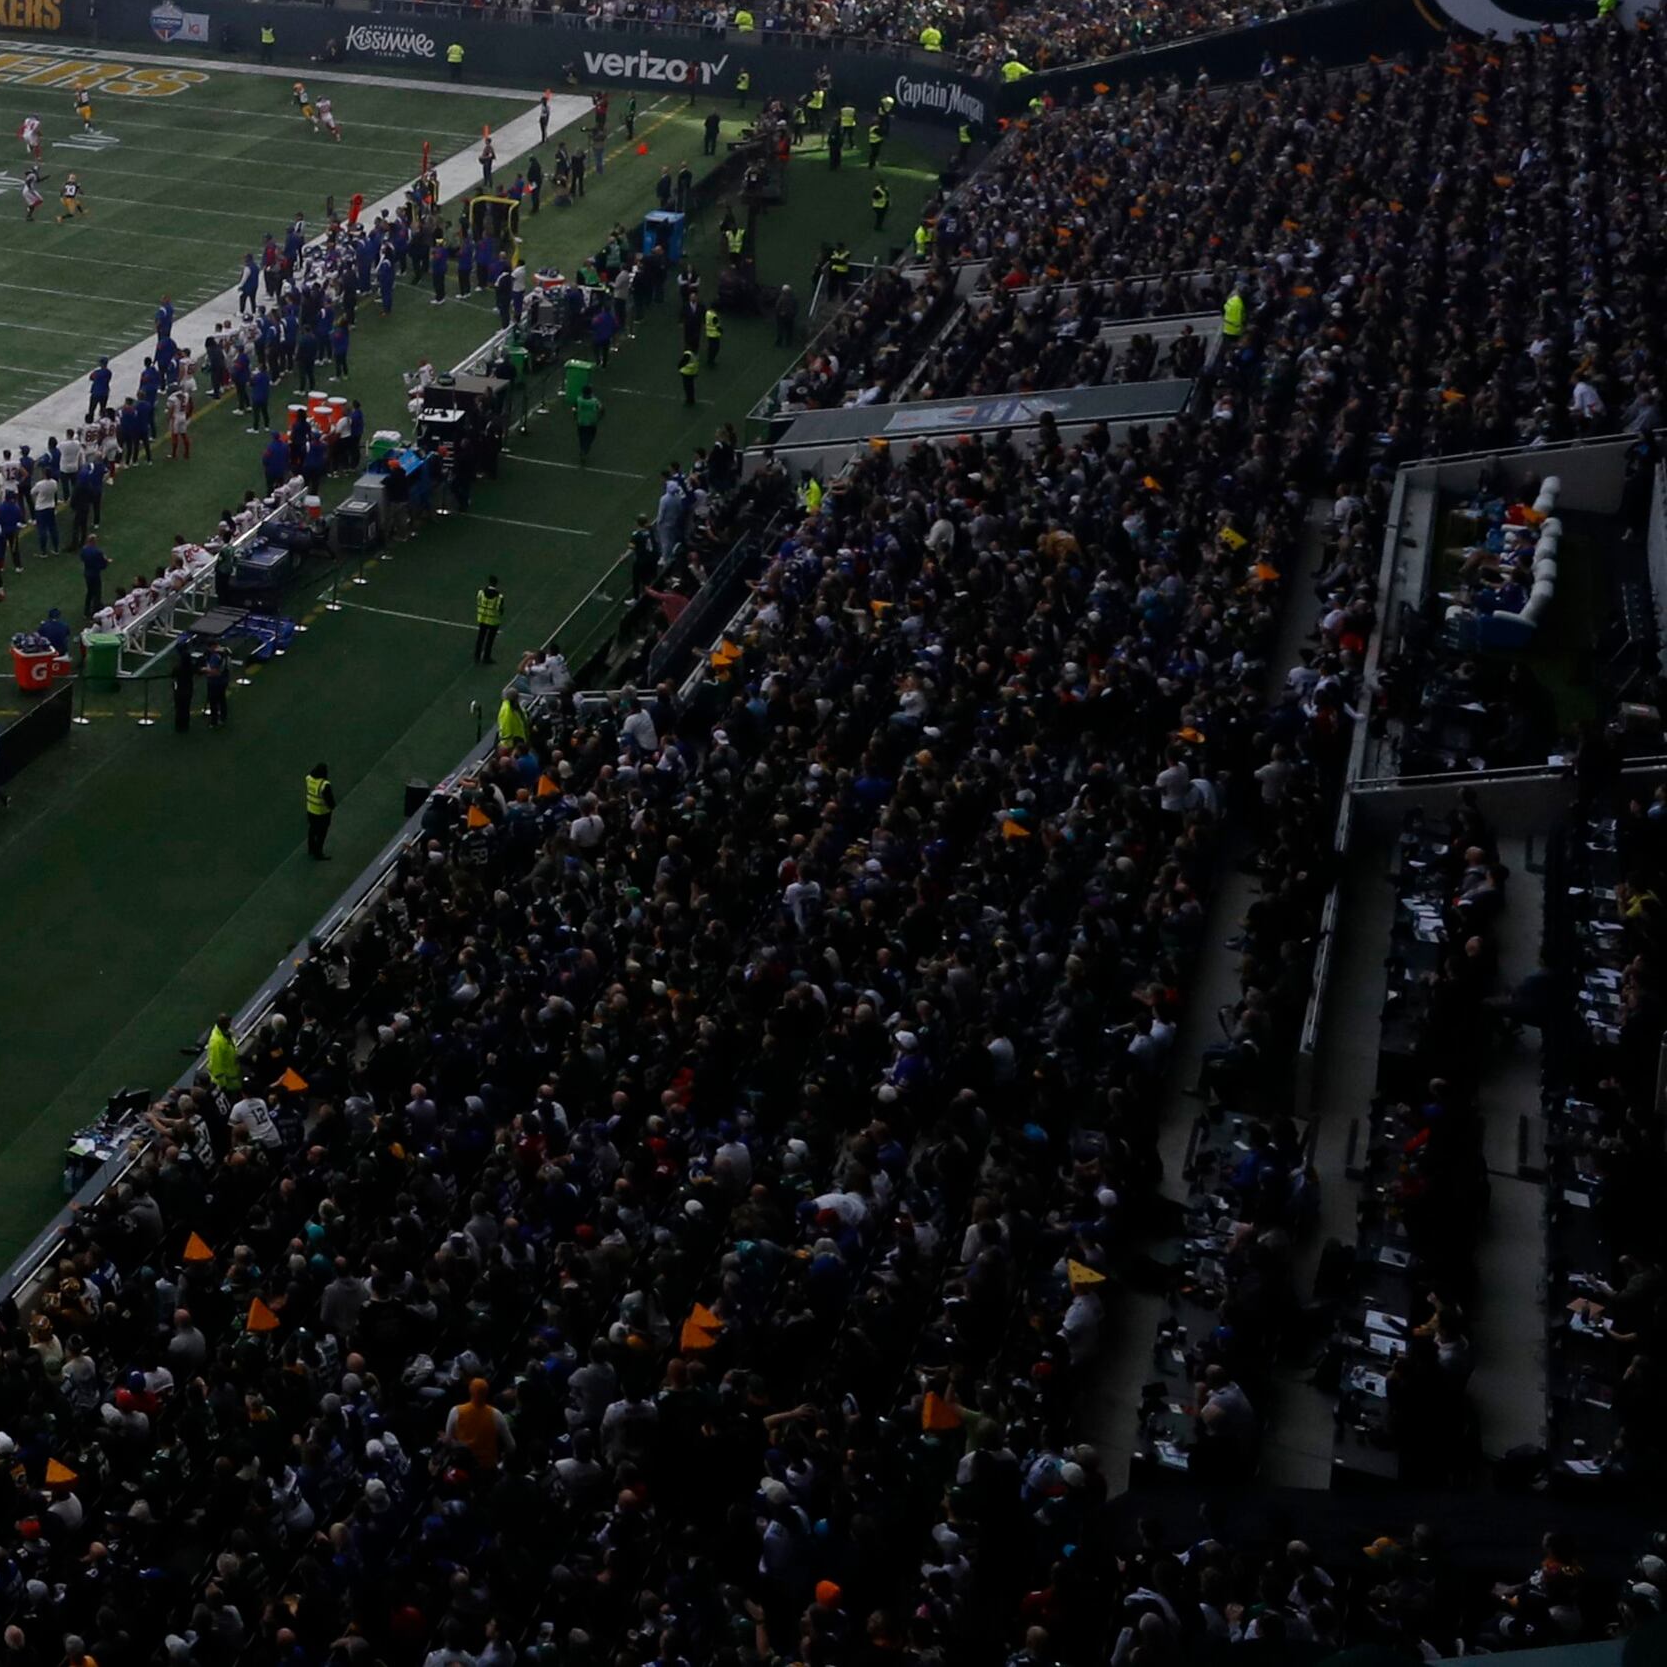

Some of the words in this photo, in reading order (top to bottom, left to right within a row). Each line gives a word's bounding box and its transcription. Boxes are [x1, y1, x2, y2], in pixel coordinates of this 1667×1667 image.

[345, 24, 436, 58] Kissimmee
[895, 74, 949, 111] Captain
[946, 79, 985, 123] Morgan
[5, 467, 18, 481] 13
